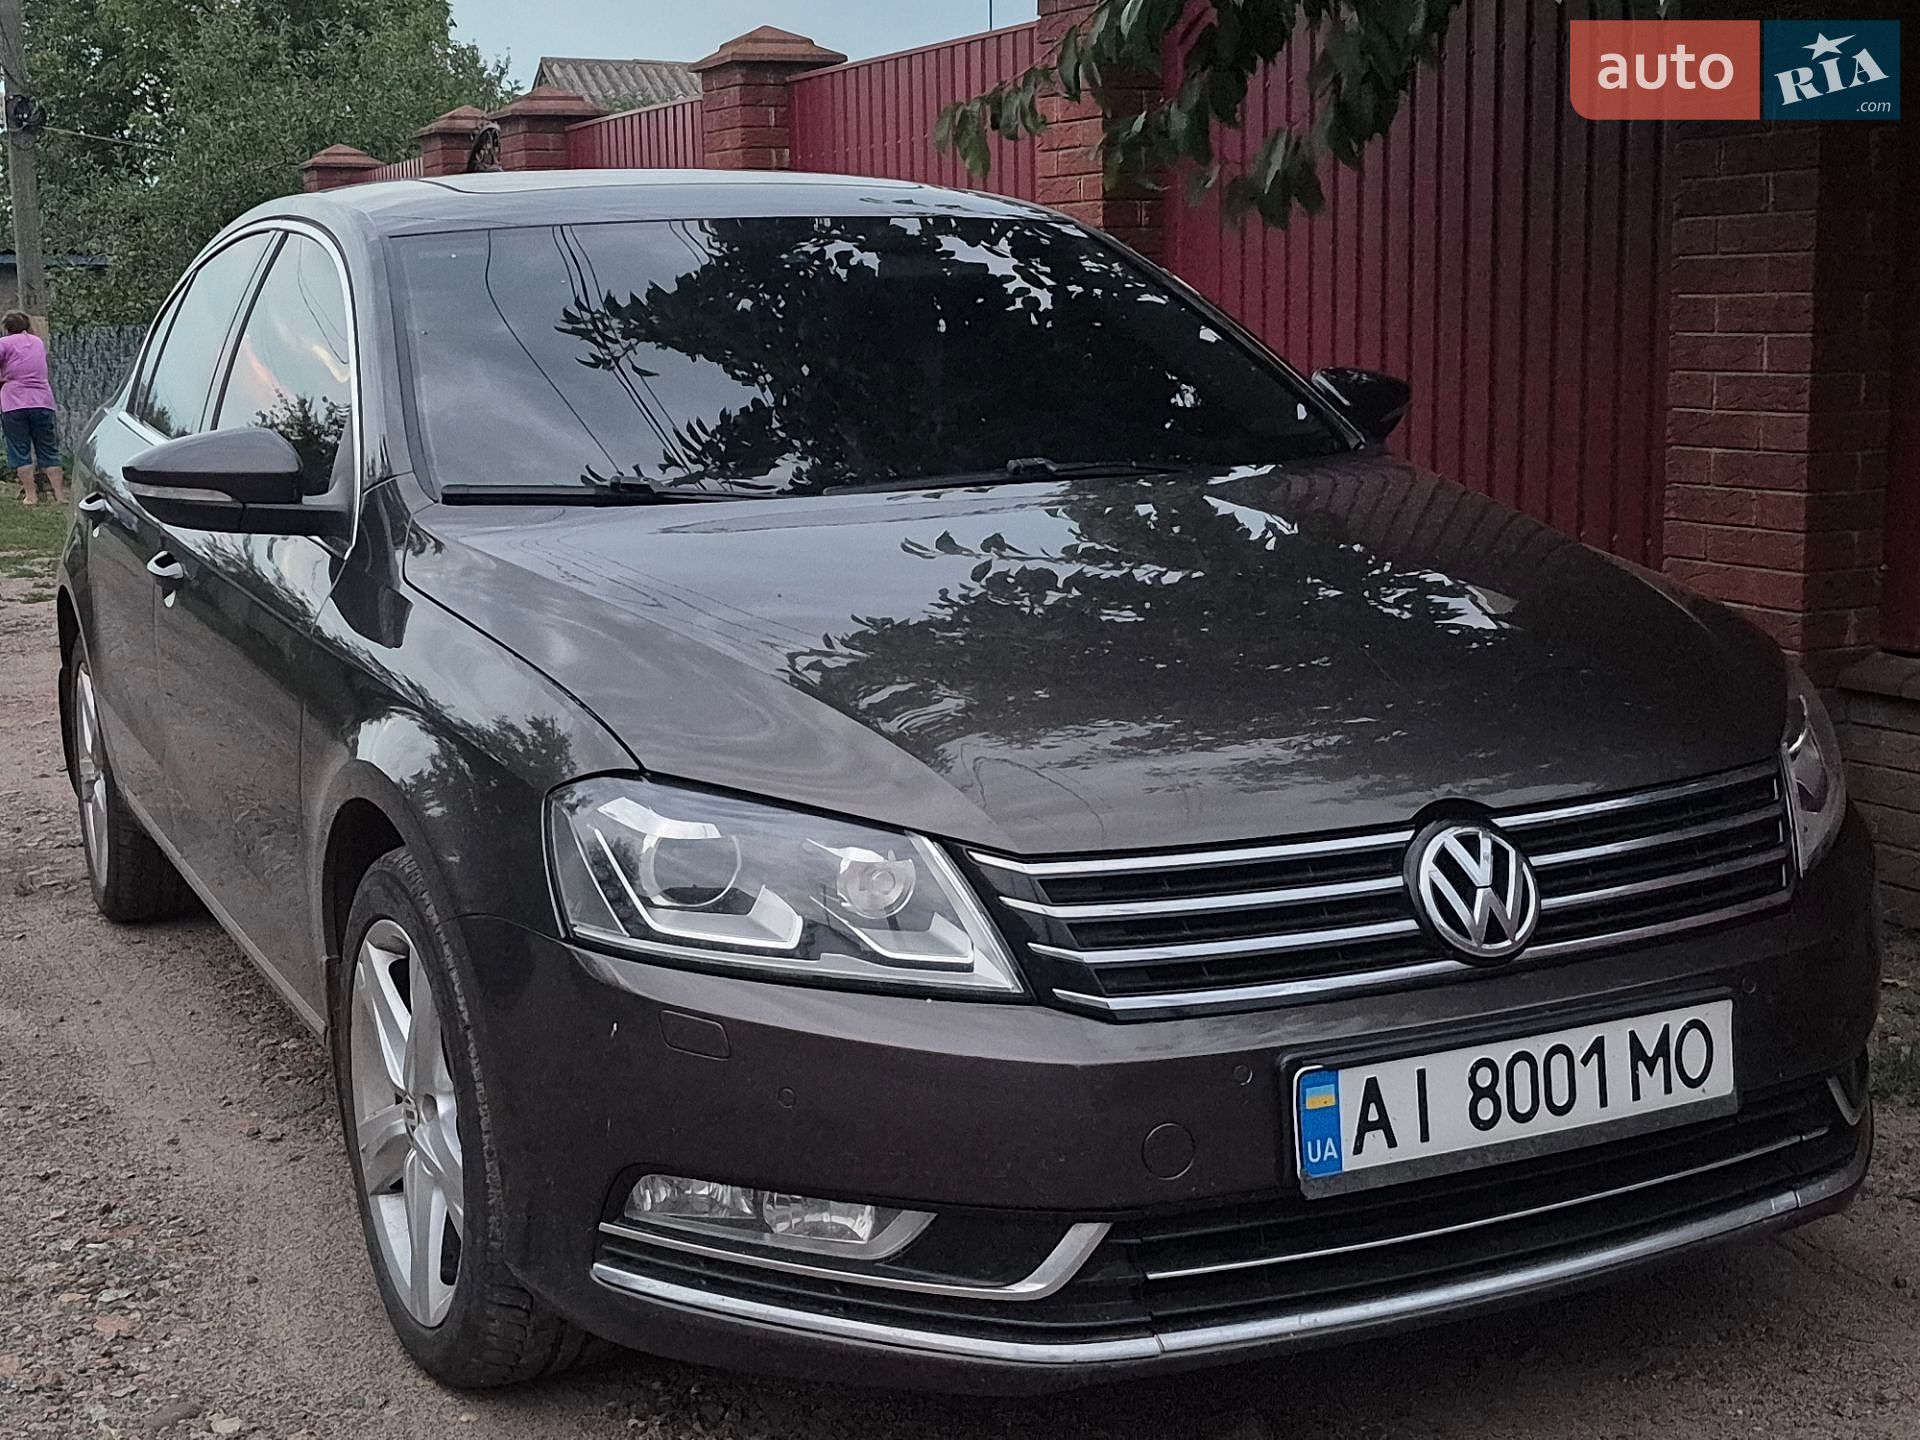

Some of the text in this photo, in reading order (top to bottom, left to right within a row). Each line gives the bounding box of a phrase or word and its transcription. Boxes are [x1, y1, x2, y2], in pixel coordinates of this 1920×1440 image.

[1467, 1034, 1609, 1132] 8001
[1628, 1017, 1715, 1103] MO
[1306, 1140, 1339, 1164] UA
